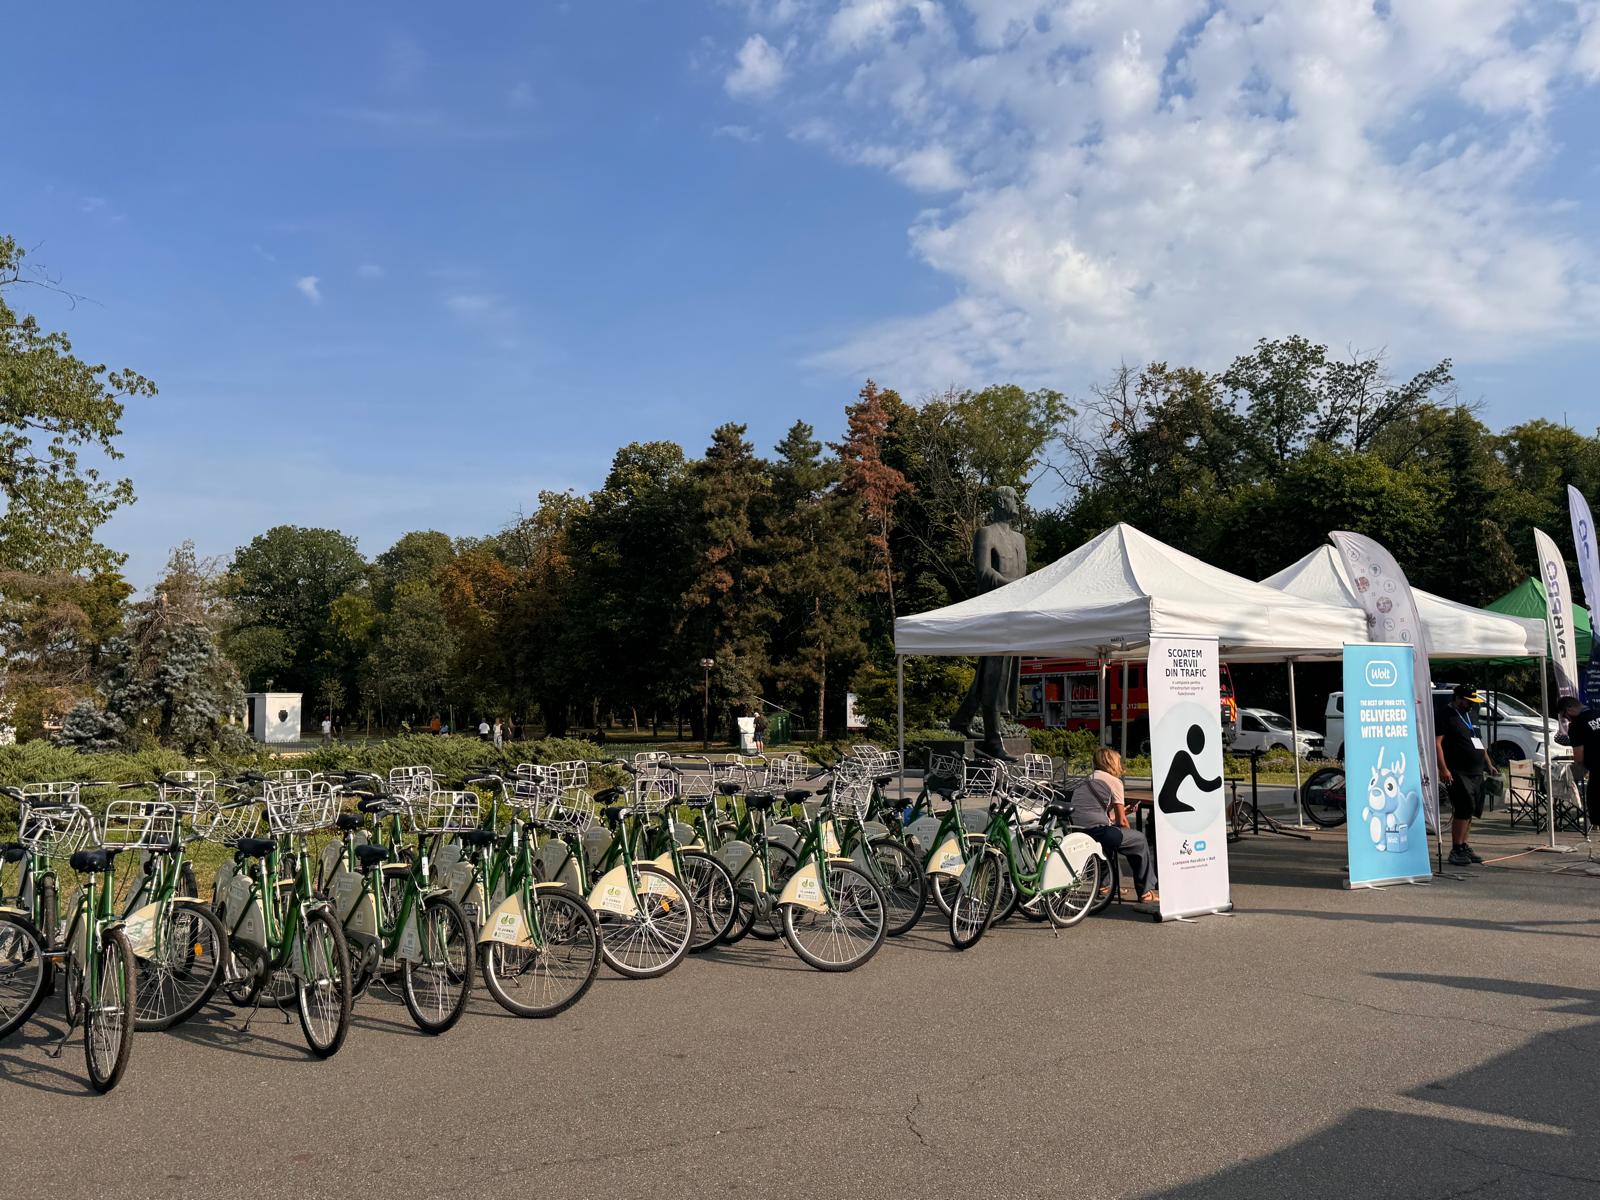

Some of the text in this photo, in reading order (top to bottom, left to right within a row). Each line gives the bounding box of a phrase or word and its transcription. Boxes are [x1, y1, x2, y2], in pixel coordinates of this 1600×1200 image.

[1167, 648, 1203, 658] SCOATEM
[1173, 659, 1198, 668] NERVII
[1165, 668, 1207, 677] DIN TRAFIC
[1371, 667, 1391, 679] Wolt
[1360, 709, 1407, 722] DELIVERED
[1361, 724, 1408, 738] WITH CARE
